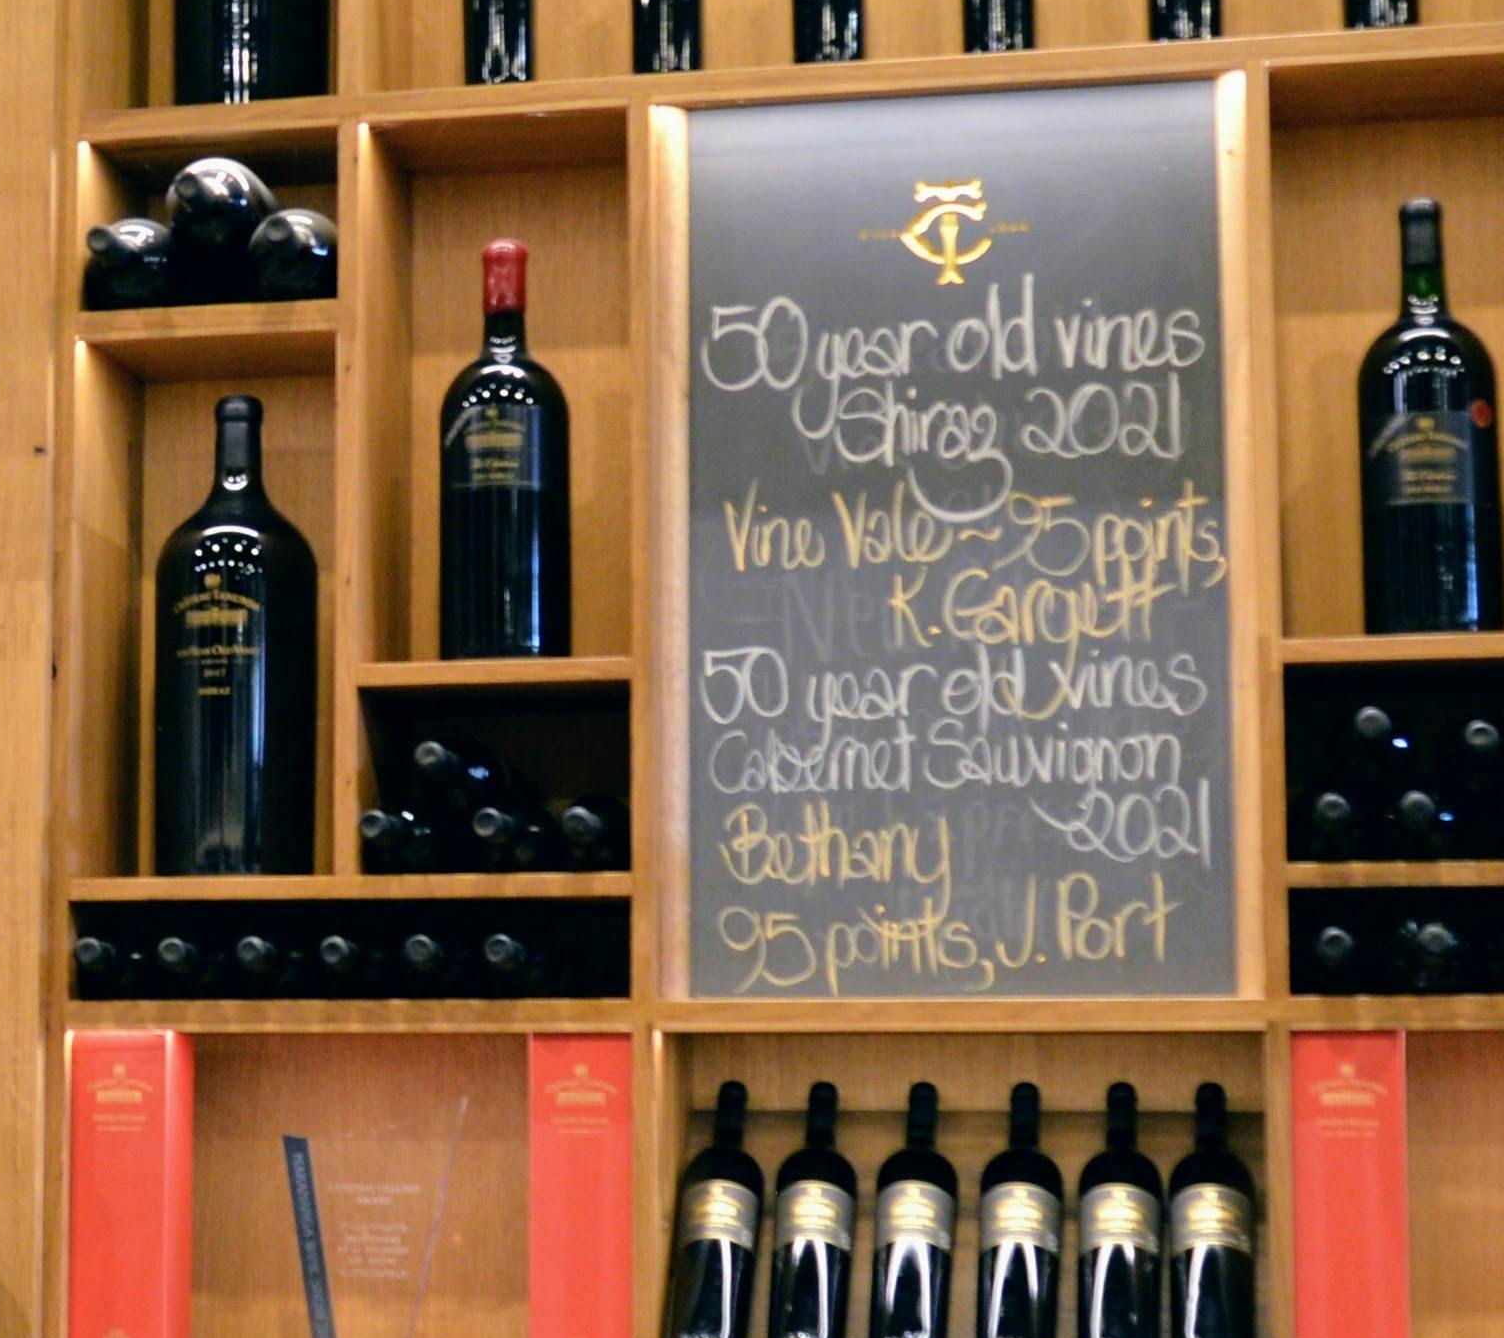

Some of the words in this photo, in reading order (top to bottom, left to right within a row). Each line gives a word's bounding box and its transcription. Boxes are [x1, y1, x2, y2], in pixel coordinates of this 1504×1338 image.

[701, 295, 809, 392] 50
[793, 318, 940, 441] year
[946, 271, 1037, 380] old
[1056, 296, 1206, 372] vines
[834, 381, 1014, 522] Shiraz
[1022, 371, 1182, 460] 2021
[724, 478, 826, 572] Vine
[834, 481, 954, 569] Vale
[701, 646, 789, 725] 50
[807, 663, 938, 757] year
[942, 644, 1025, 731] old
[1049, 649, 1209, 717] vines
[708, 719, 916, 793] Cabernet
[922, 718, 1180, 803] Sauvignon
[719, 801, 952, 923] Bethany
[1066, 778, 1211, 870] 2021
[717, 904, 818, 994] 95
